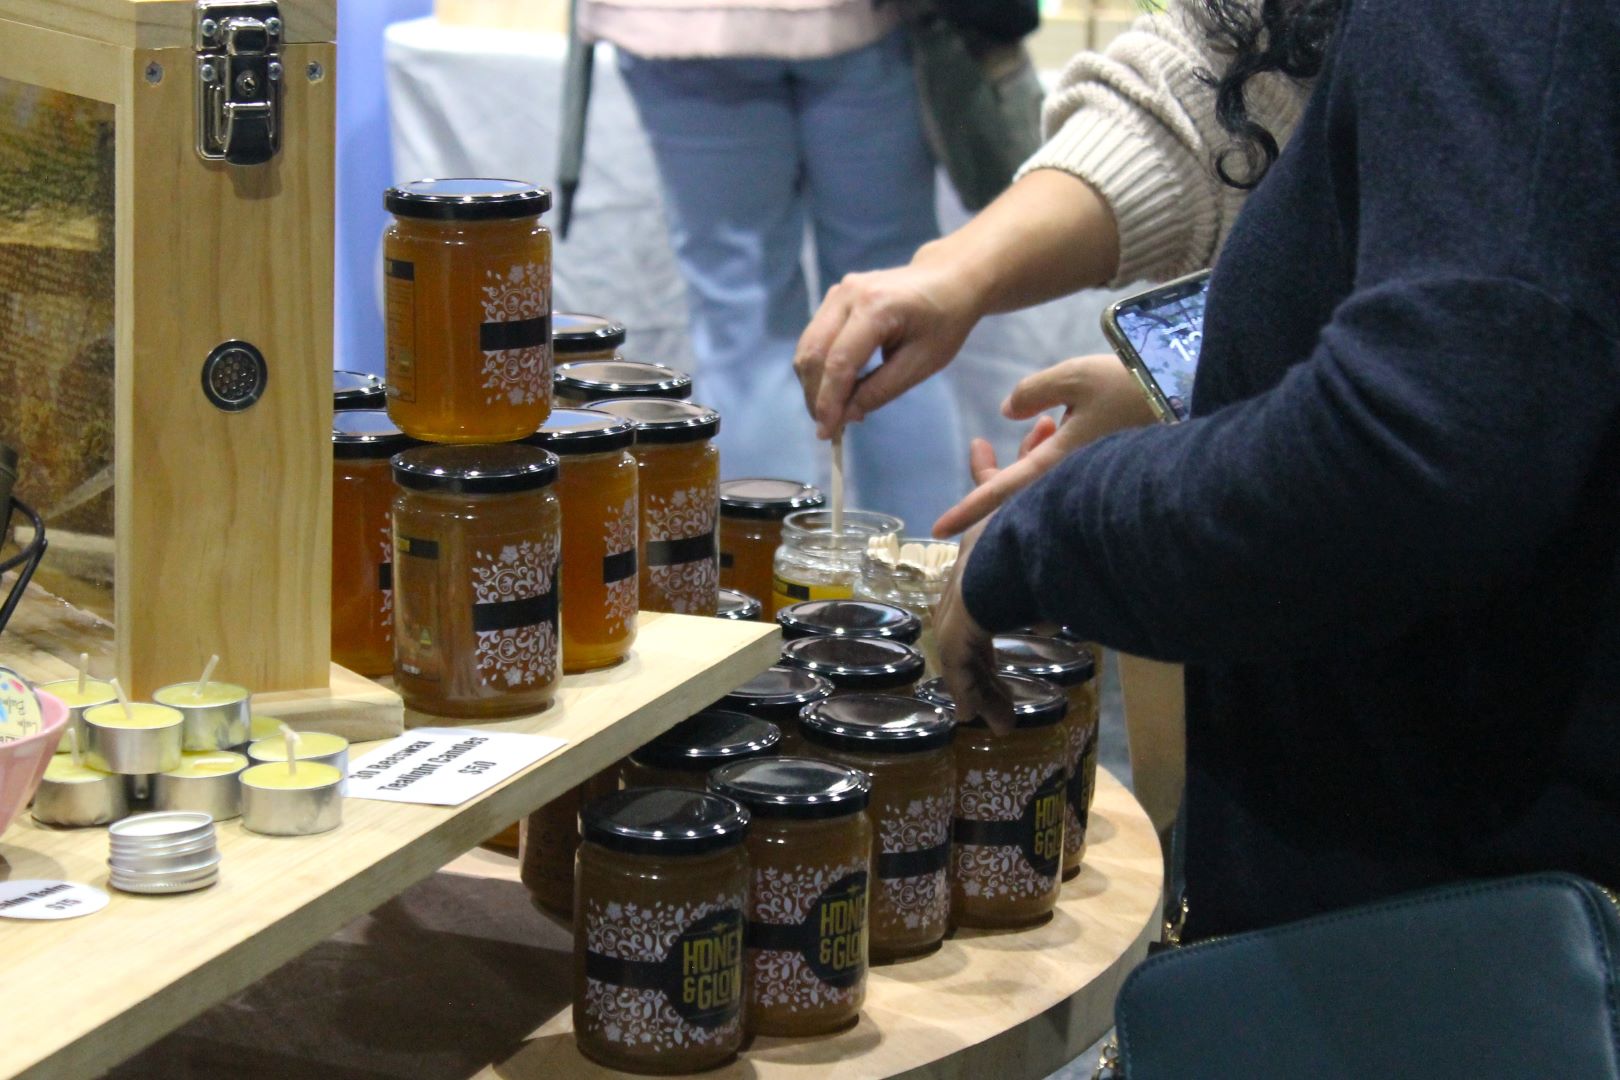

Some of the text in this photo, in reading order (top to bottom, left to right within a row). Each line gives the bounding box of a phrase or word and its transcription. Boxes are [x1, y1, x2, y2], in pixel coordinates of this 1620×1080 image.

[368, 739, 436, 771] Beeswax
[377, 736, 489, 791] Tealight Candles
[458, 760, 497, 776] $50
